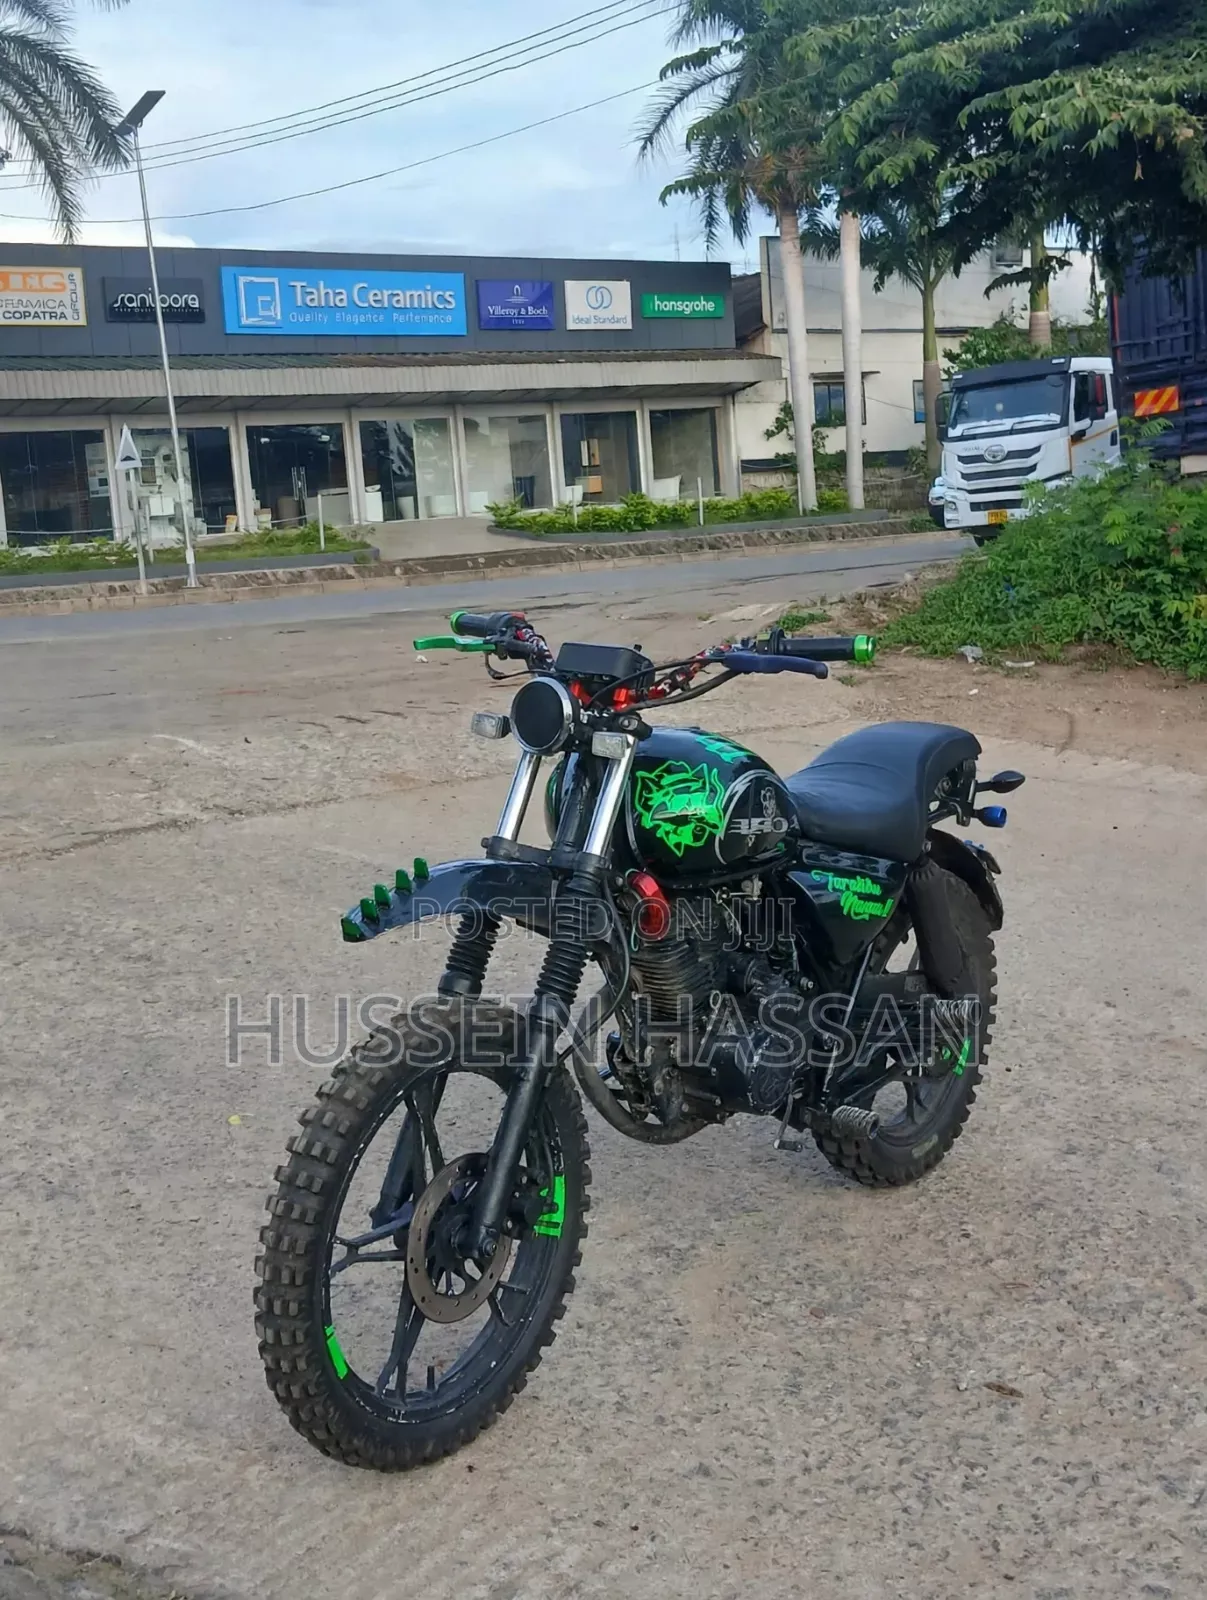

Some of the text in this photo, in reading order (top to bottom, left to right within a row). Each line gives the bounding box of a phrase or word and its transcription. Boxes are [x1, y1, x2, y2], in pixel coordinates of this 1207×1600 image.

[288, 280, 456, 309] Taha Ceramics
[487, 304, 549, 317] Villeroy & Boch
[289, 312, 328, 324] Quality
[571, 313, 628, 325] Ideal Standard
